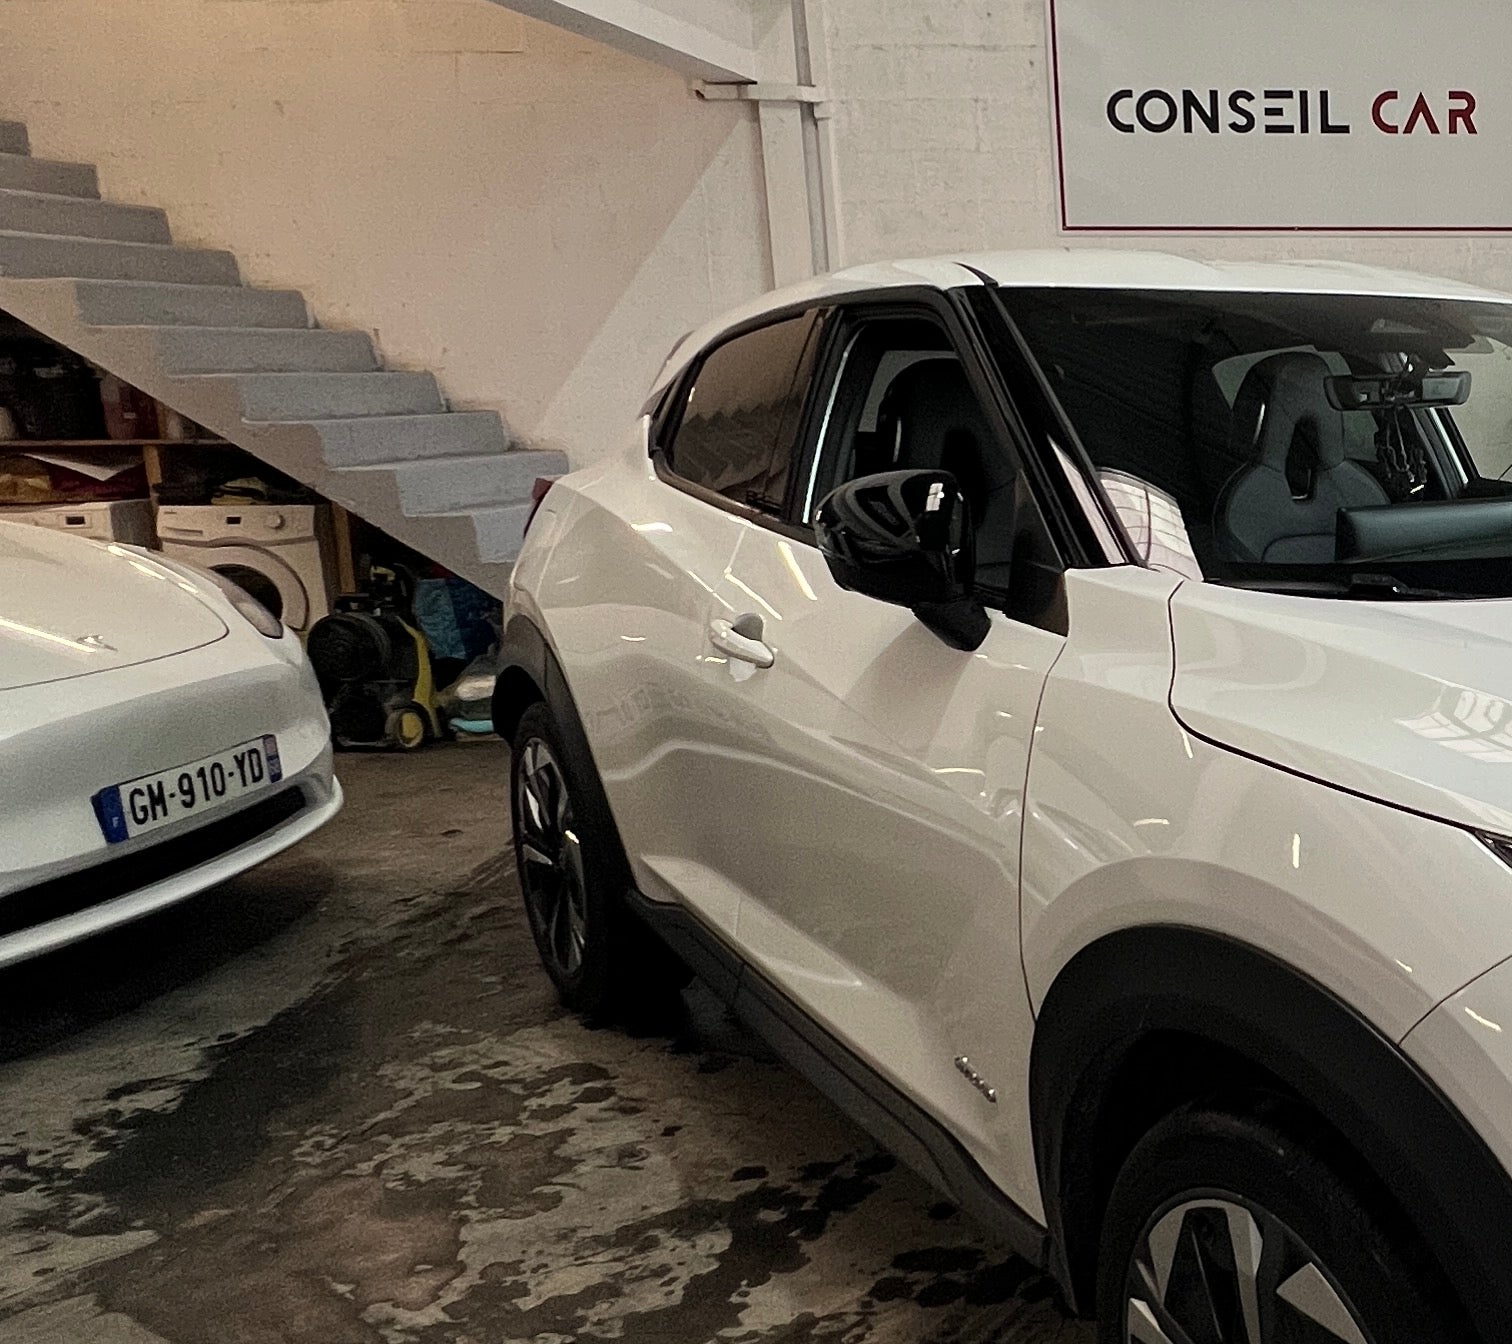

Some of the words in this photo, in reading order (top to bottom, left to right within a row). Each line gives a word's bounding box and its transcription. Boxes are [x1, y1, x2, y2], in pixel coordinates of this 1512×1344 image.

[1106, 89, 1350, 134] CONSEIL
[1371, 90, 1478, 134] CAR
[129, 748, 263, 825] GM-910-YD
